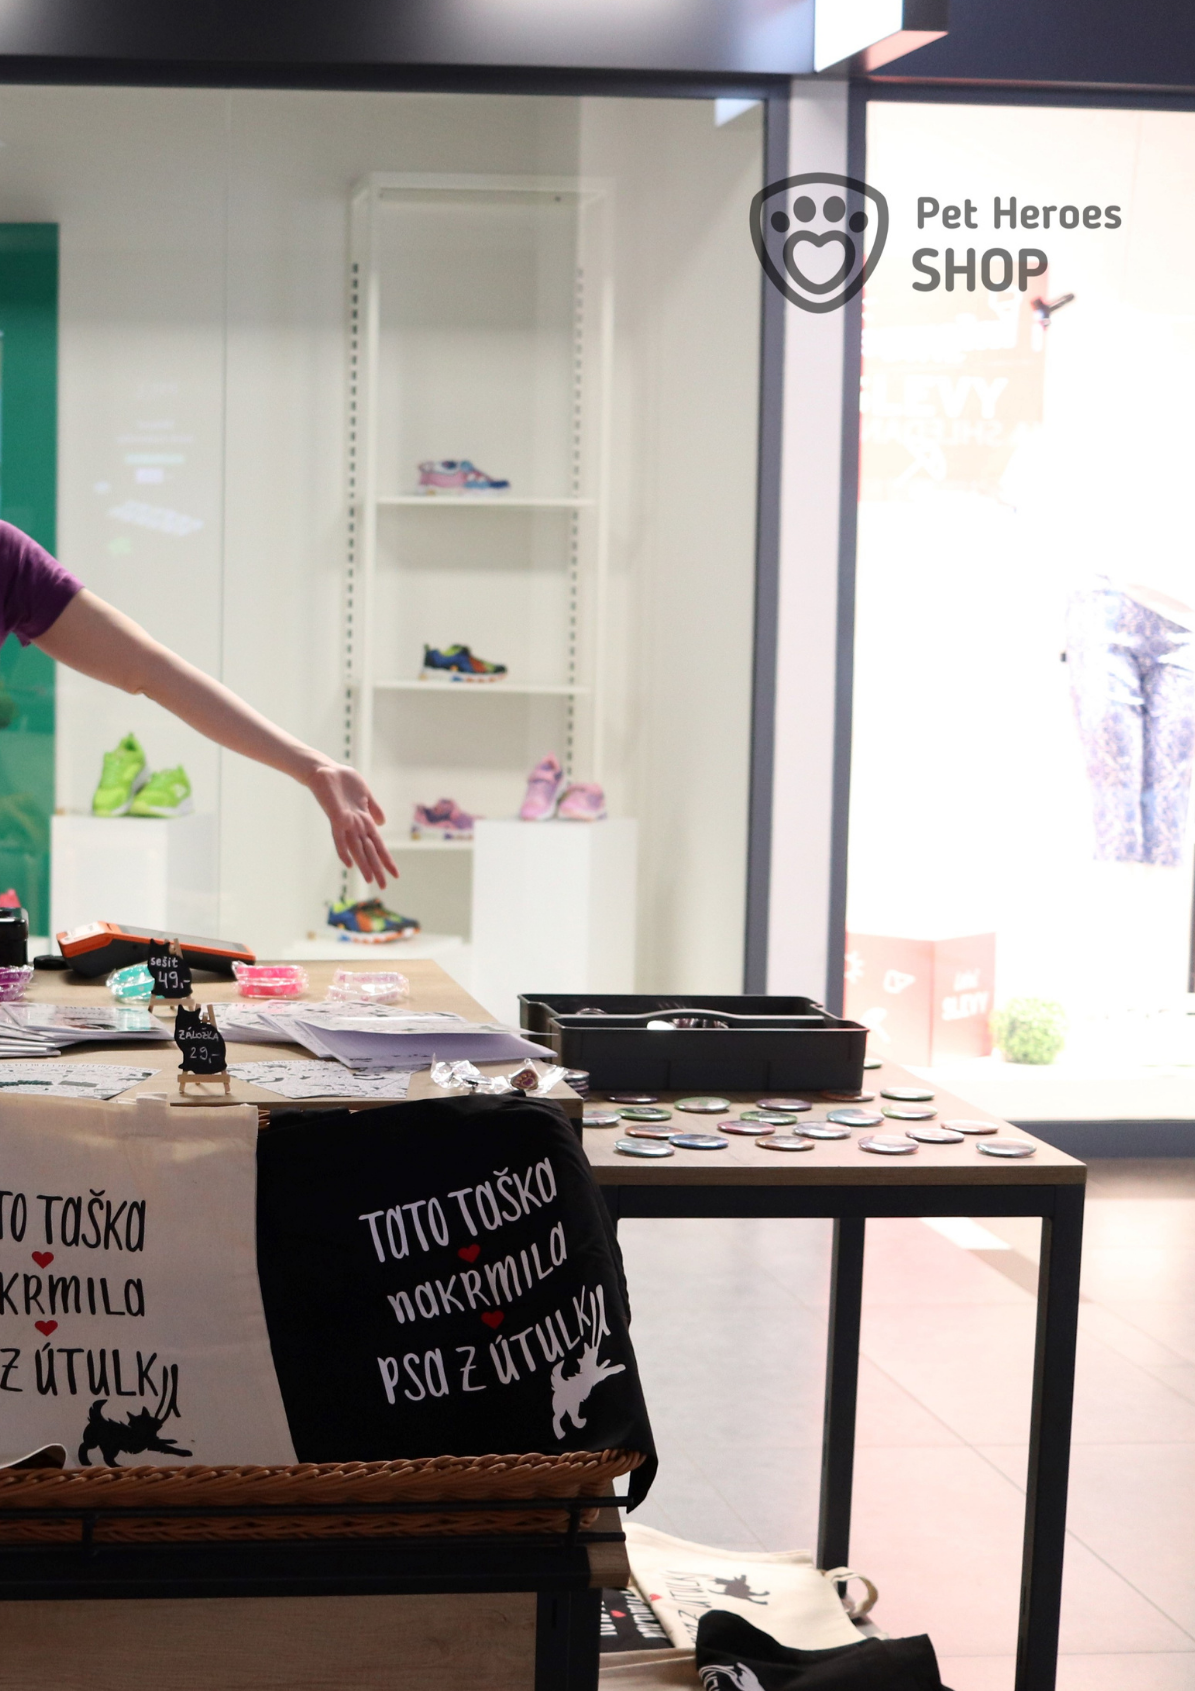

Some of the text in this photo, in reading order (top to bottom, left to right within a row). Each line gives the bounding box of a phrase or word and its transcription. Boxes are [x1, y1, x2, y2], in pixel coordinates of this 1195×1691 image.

[149, 956, 179, 969] sešit
[0, 1348, 24, 1393] Z
[455, 1346, 488, 1393] Z
